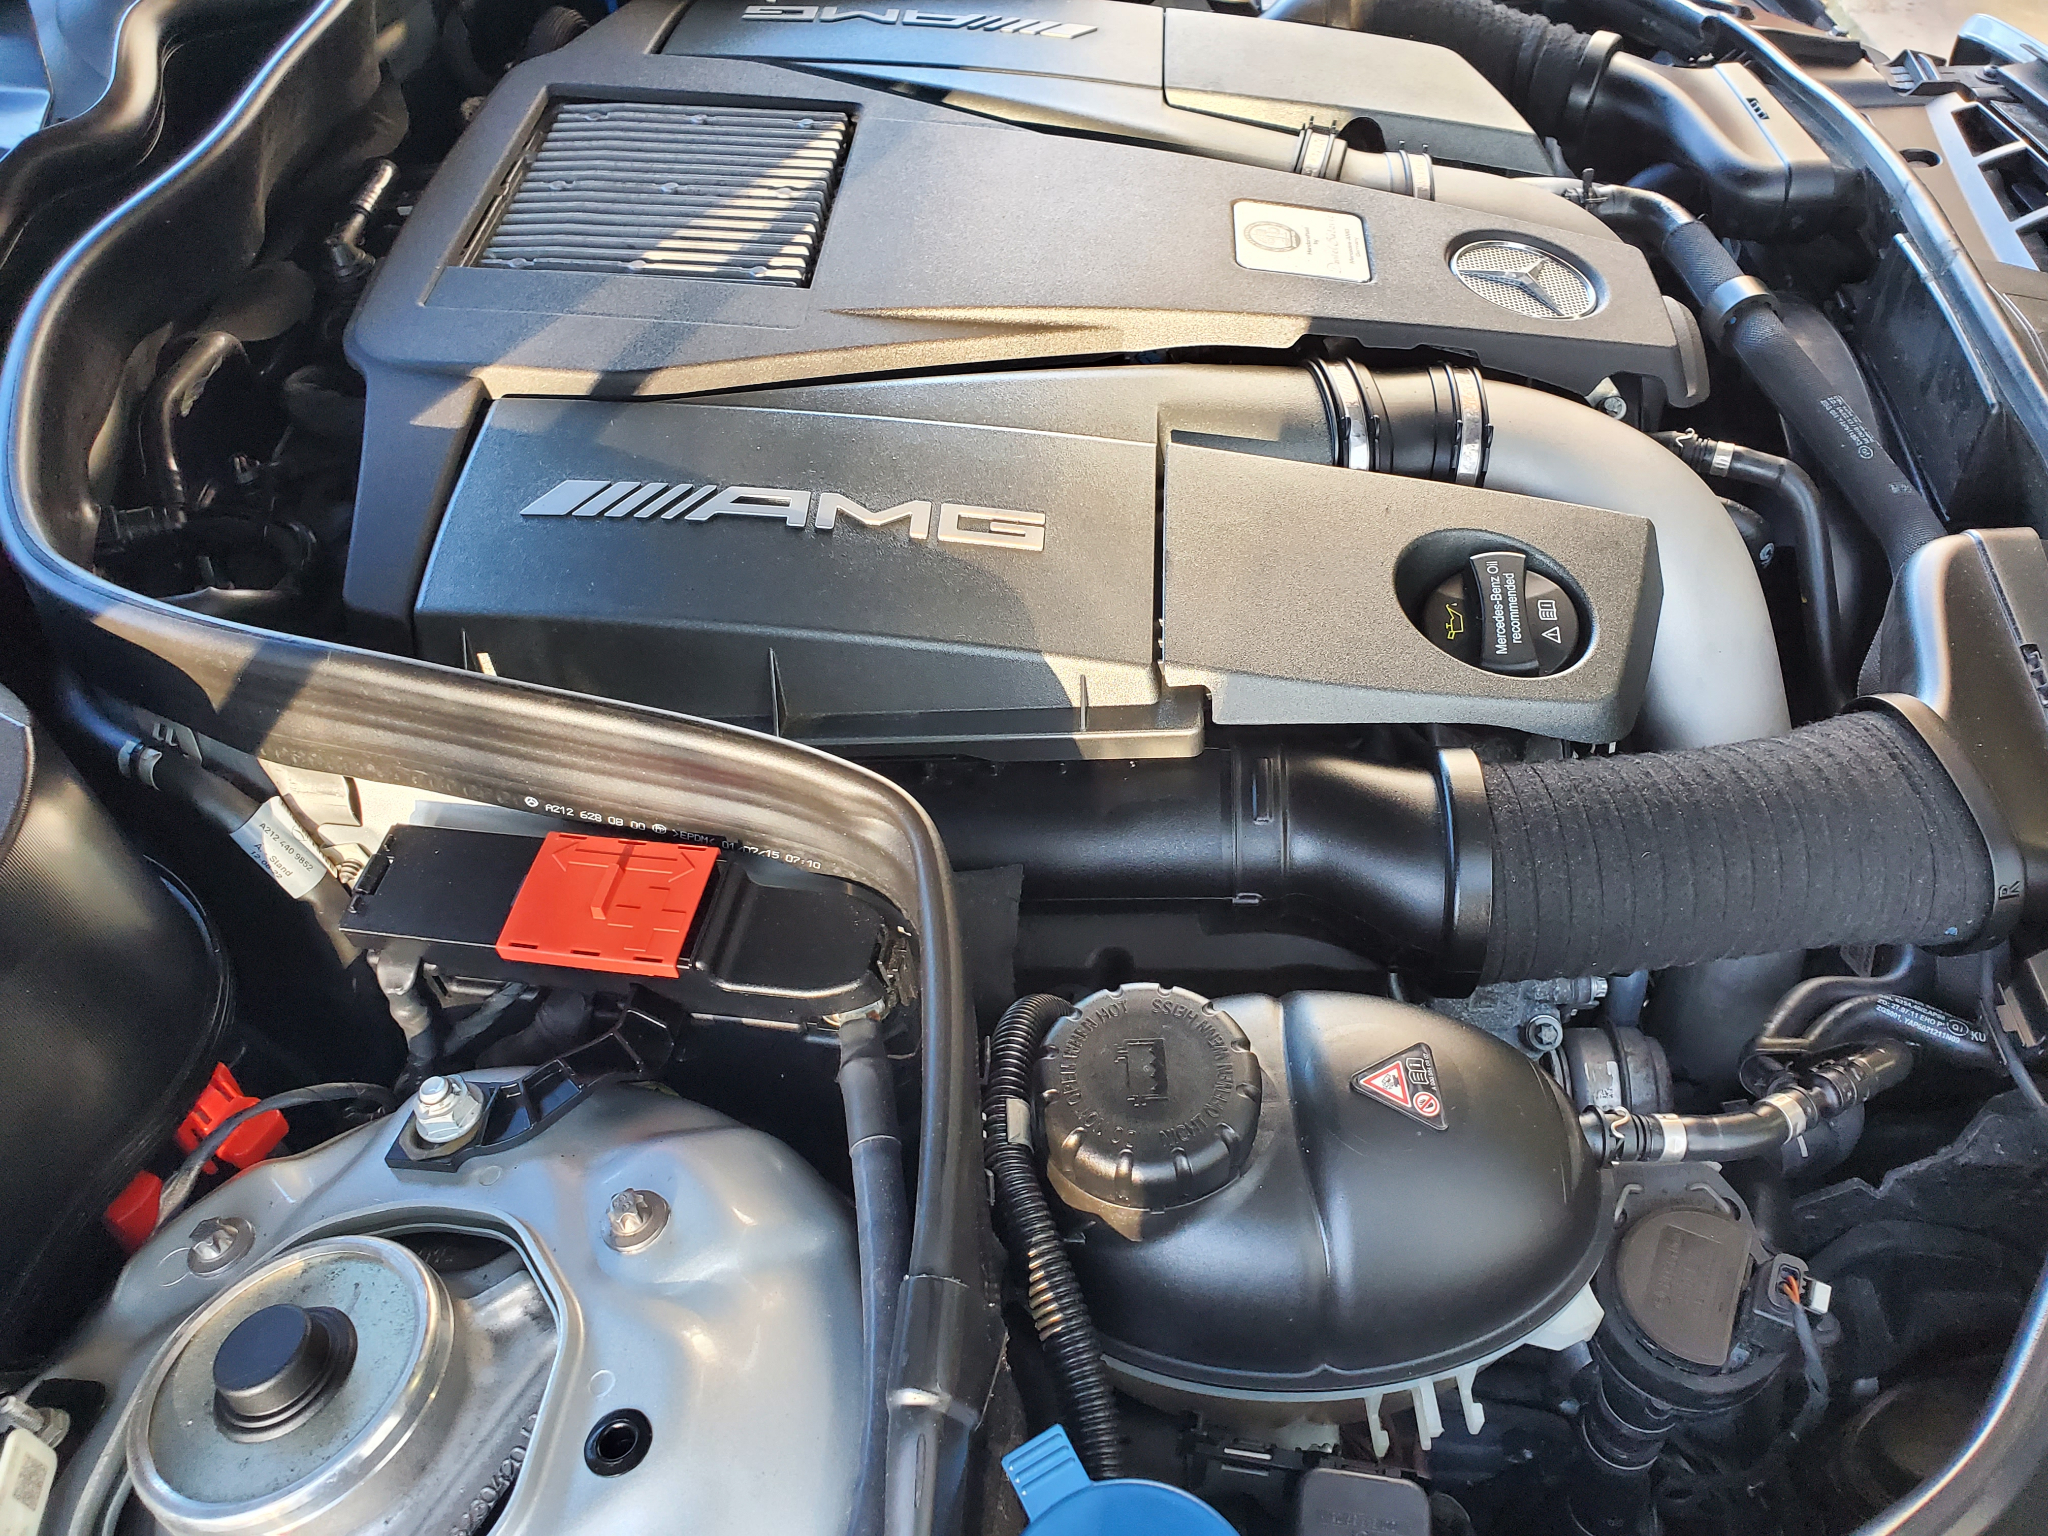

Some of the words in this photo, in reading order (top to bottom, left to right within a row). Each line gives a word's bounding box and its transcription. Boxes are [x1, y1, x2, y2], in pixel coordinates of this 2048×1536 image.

[742, 6, 986, 29] AMG
[685, 486, 1046, 552] AMG
[1486, 561, 1499, 574] Oil
[1490, 576, 1508, 655] Mercedes-Benz
[1503, 573, 1522, 644] recommended
[259, 823, 280, 841] A212
[280, 841, 295, 855] 440
[294, 853, 314, 872] 9852
[545, 804, 574, 816] A212
[580, 811, 602, 823] 628
[630, 820, 646, 831] 00
[785, 854, 821, 870] 07:10
[1096, 999, 1129, 1024] HOT
[1151, 998, 1198, 1024] HEISS
[1062, 1018, 1098, 1060] WHEN
[1060, 1064, 1082, 1106] OPEN
